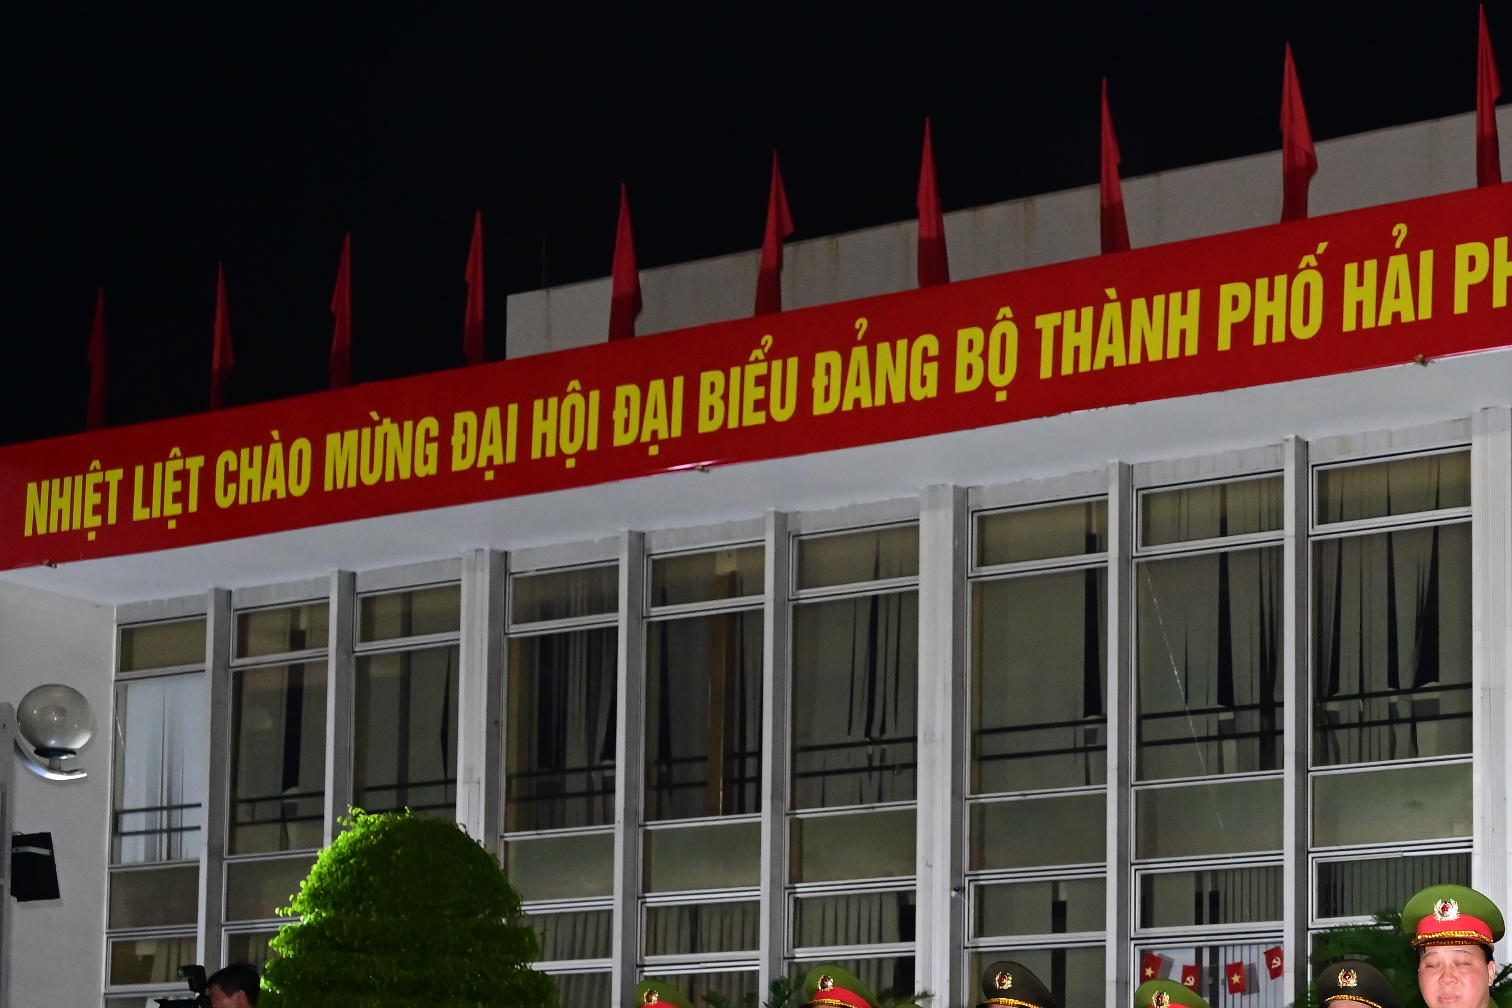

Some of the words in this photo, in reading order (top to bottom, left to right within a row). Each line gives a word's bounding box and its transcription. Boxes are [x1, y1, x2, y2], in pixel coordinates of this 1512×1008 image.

[25, 460, 124, 541] NHIỆT
[133, 447, 205, 529] LIỆT
[215, 430, 312, 508] CHÀO
[324, 411, 440, 491] MỪNG
[451, 403, 519, 481] ĐẠI
[531, 380, 600, 468] HỘI
[613, 375, 685, 456] ĐẠI
[699, 335, 799, 433] BIỂU
[812, 317, 940, 415] ĐẢNG
[955, 306, 1019, 402] BỘ
[1036, 287, 1201, 379] THÀNH
[1218, 242, 1328, 351] PHỐ
[1343, 223, 1434, 332] HẢI
